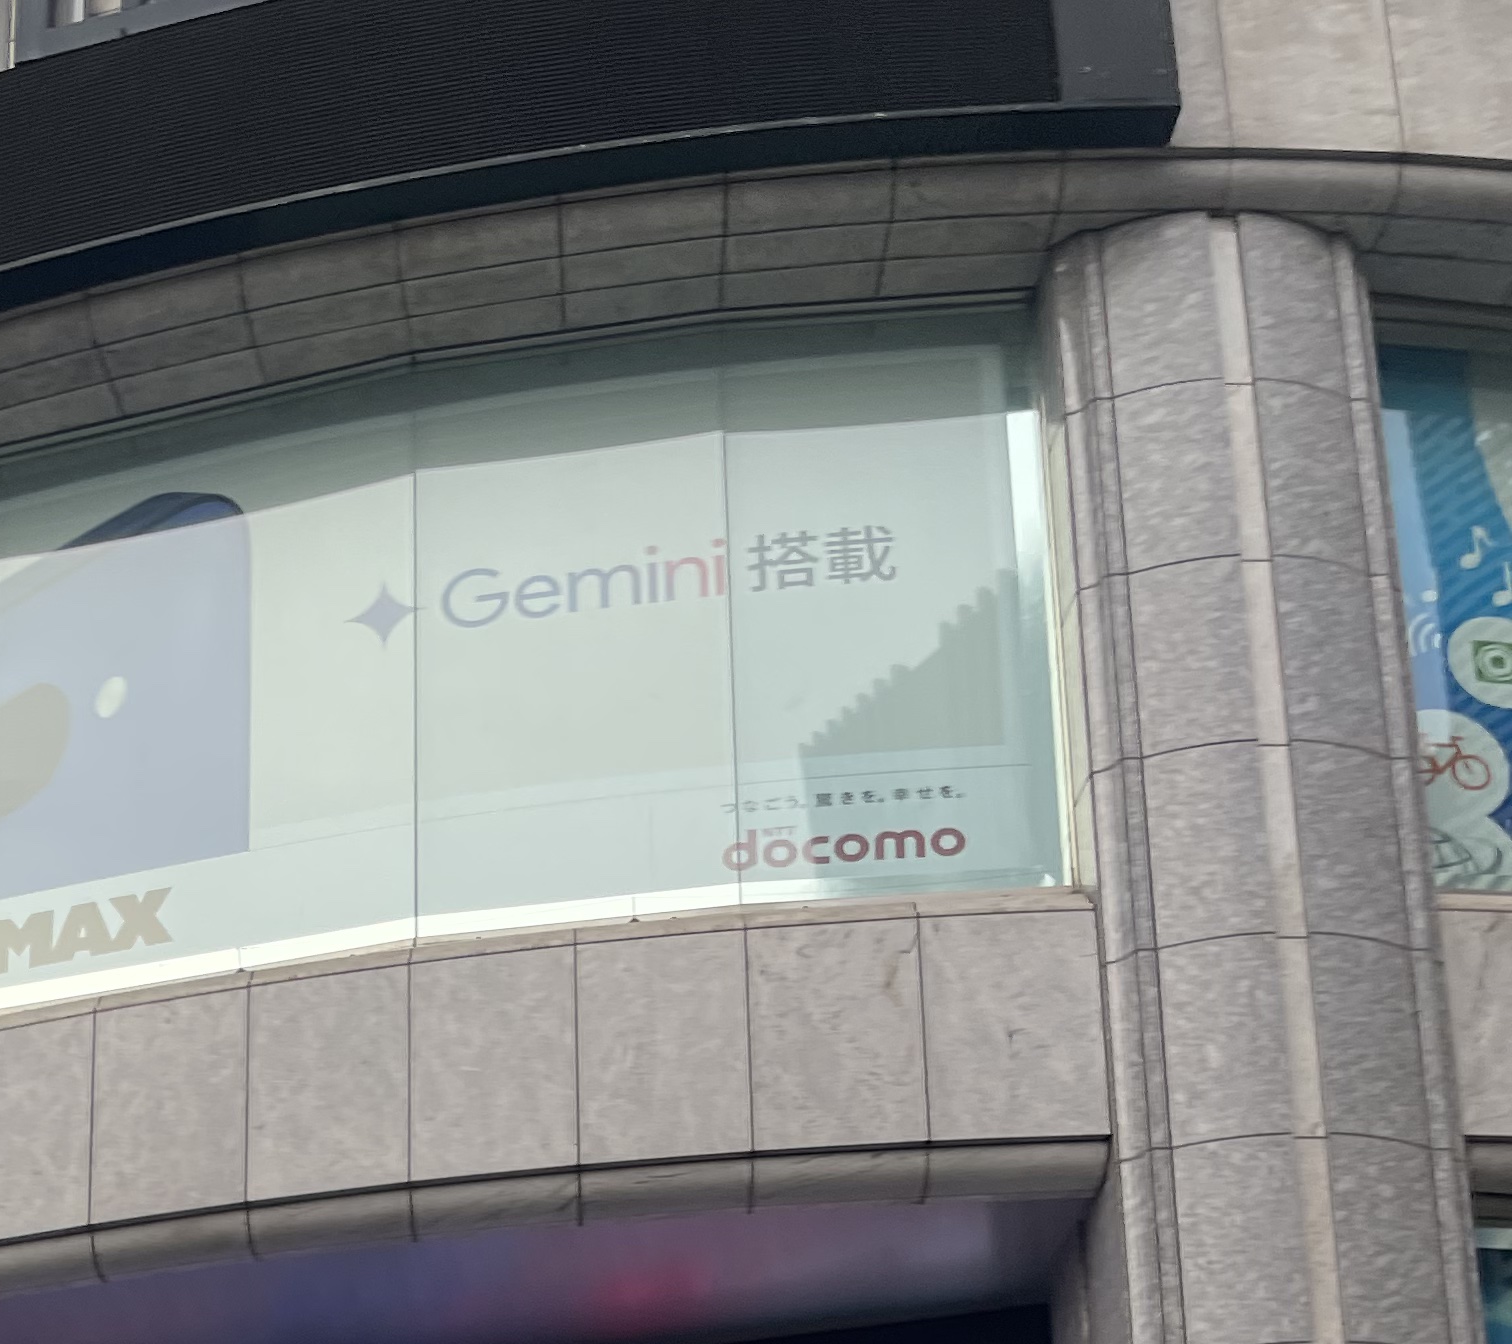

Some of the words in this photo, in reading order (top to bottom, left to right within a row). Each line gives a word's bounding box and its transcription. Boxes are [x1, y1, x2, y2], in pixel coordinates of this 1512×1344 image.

[441, 539, 727, 629] Gemini
[746, 526, 898, 593] 搭載
[721, 827, 967, 871] docomo
